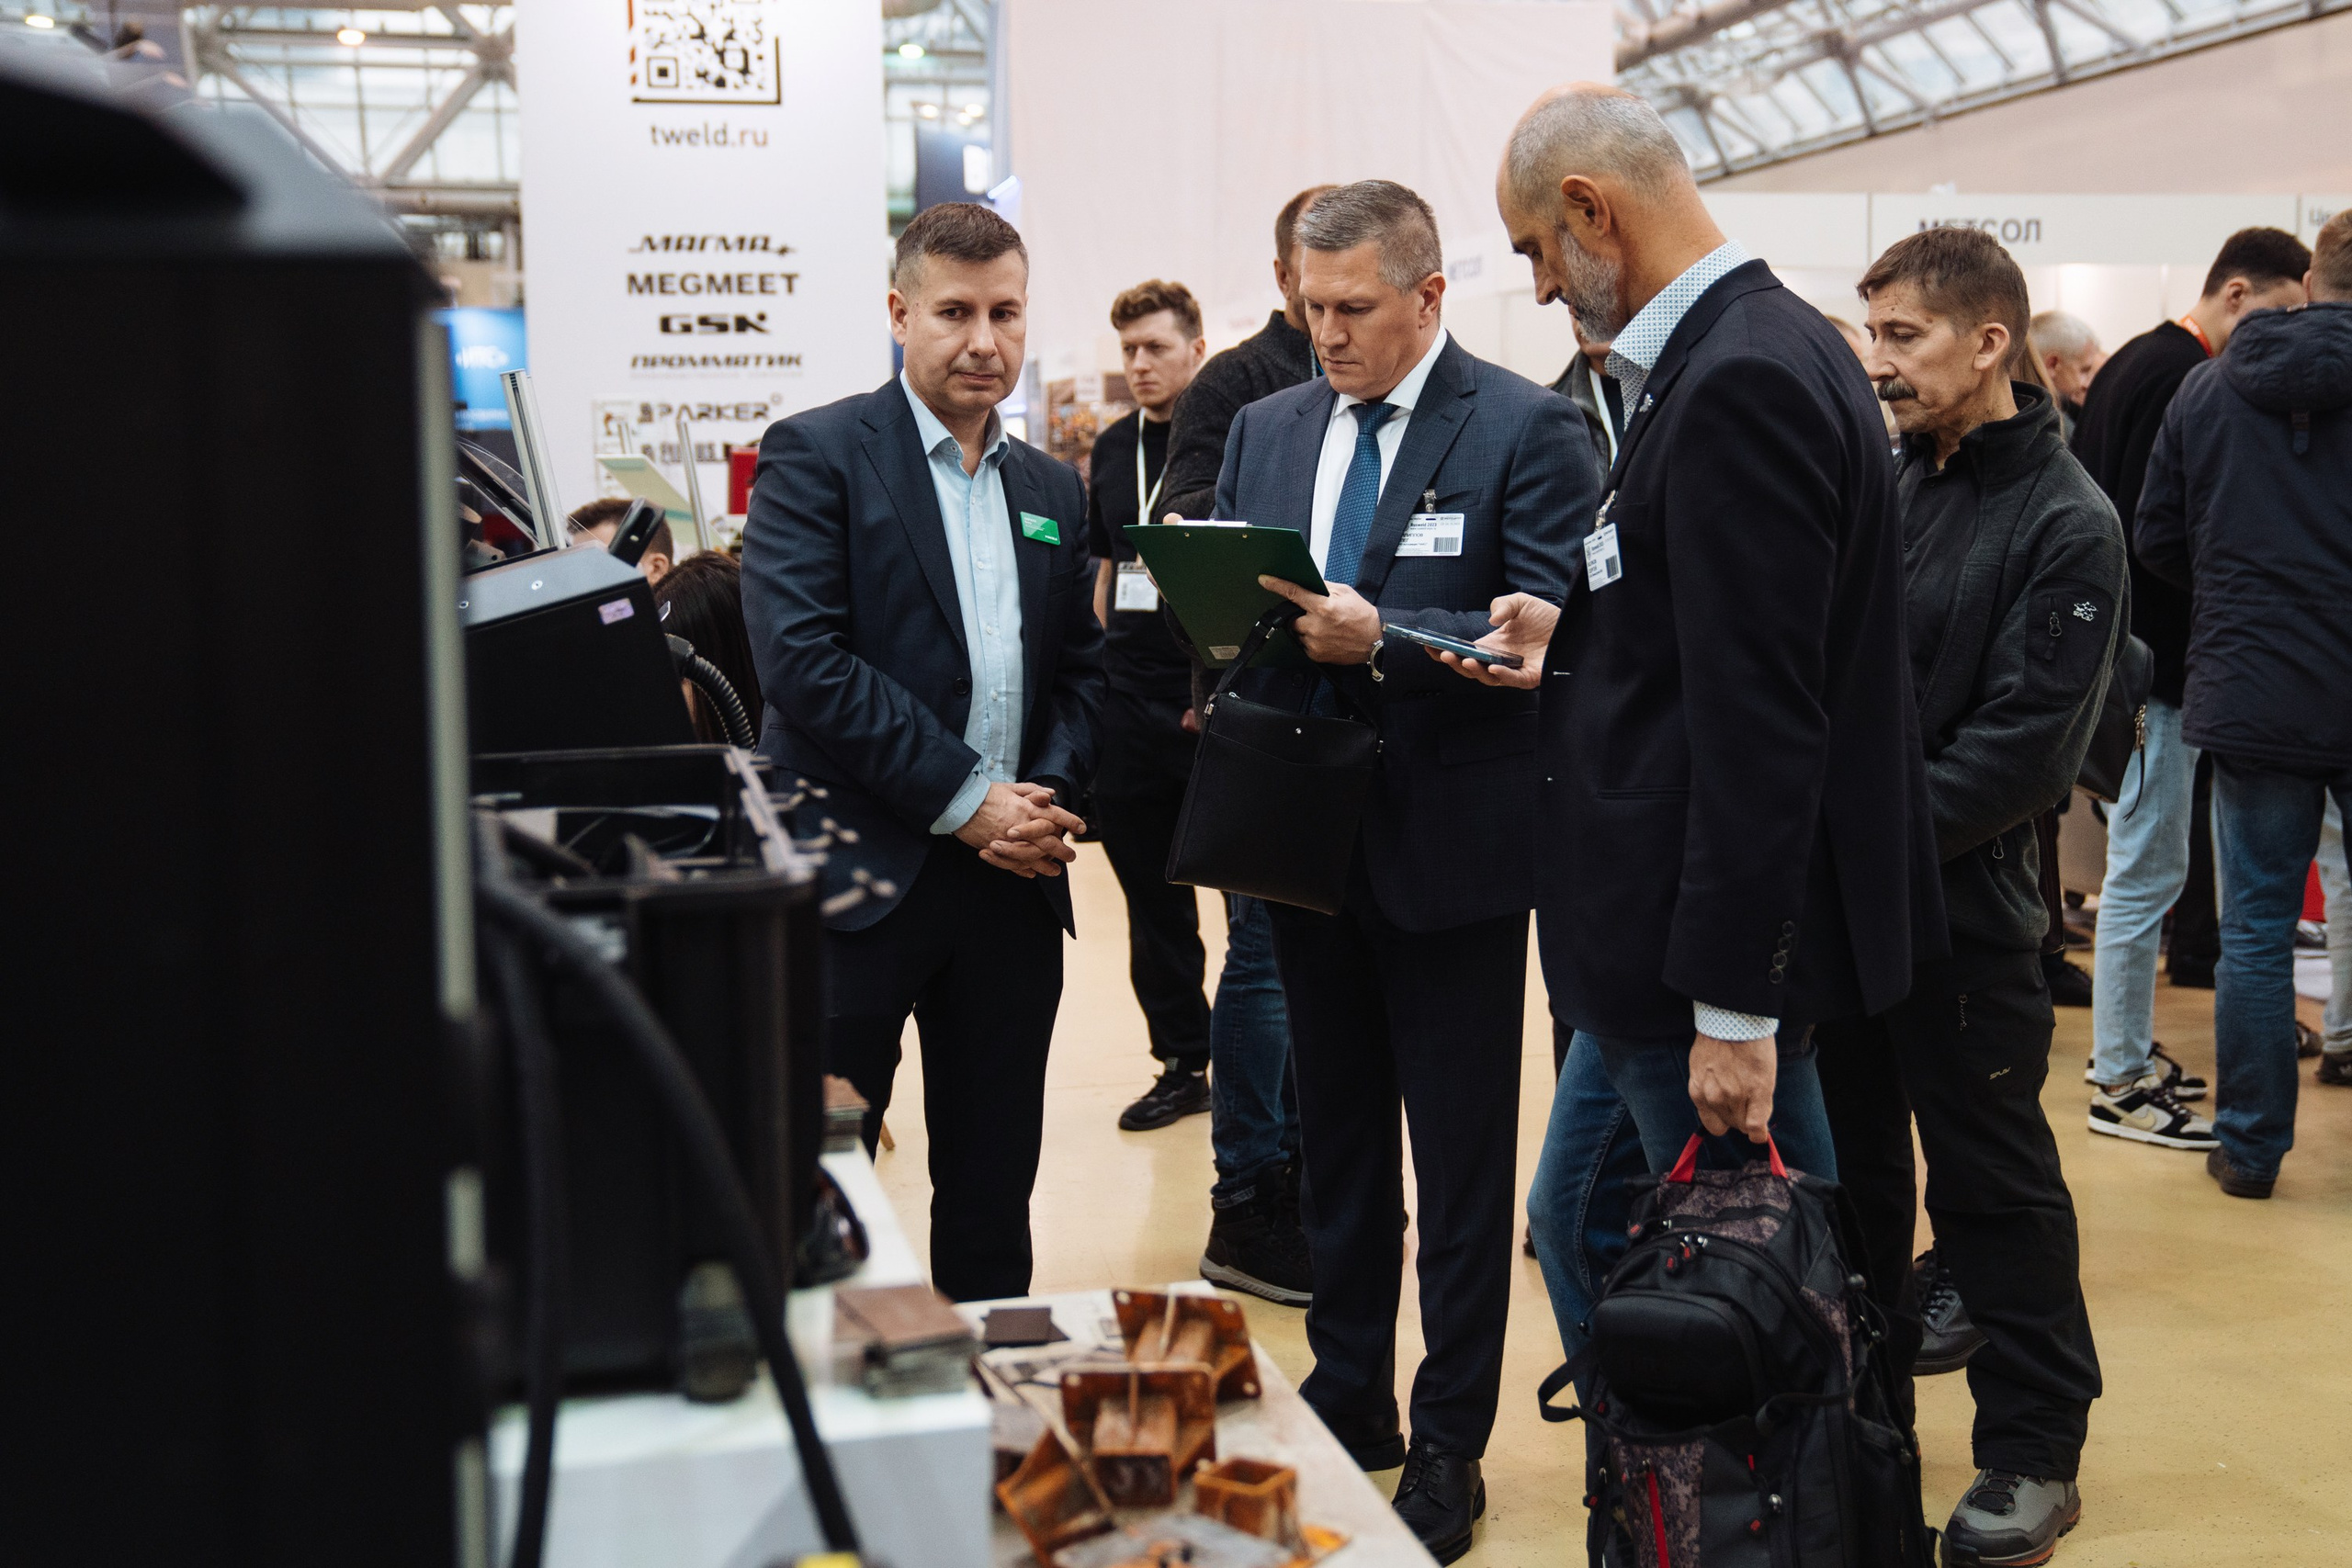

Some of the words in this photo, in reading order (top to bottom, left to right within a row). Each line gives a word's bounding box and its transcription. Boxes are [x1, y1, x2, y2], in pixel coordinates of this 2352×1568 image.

[650, 120, 769, 147] tweld.ru
[628, 273, 798, 295] MEGMEET
[660, 311, 770, 334] GSK
